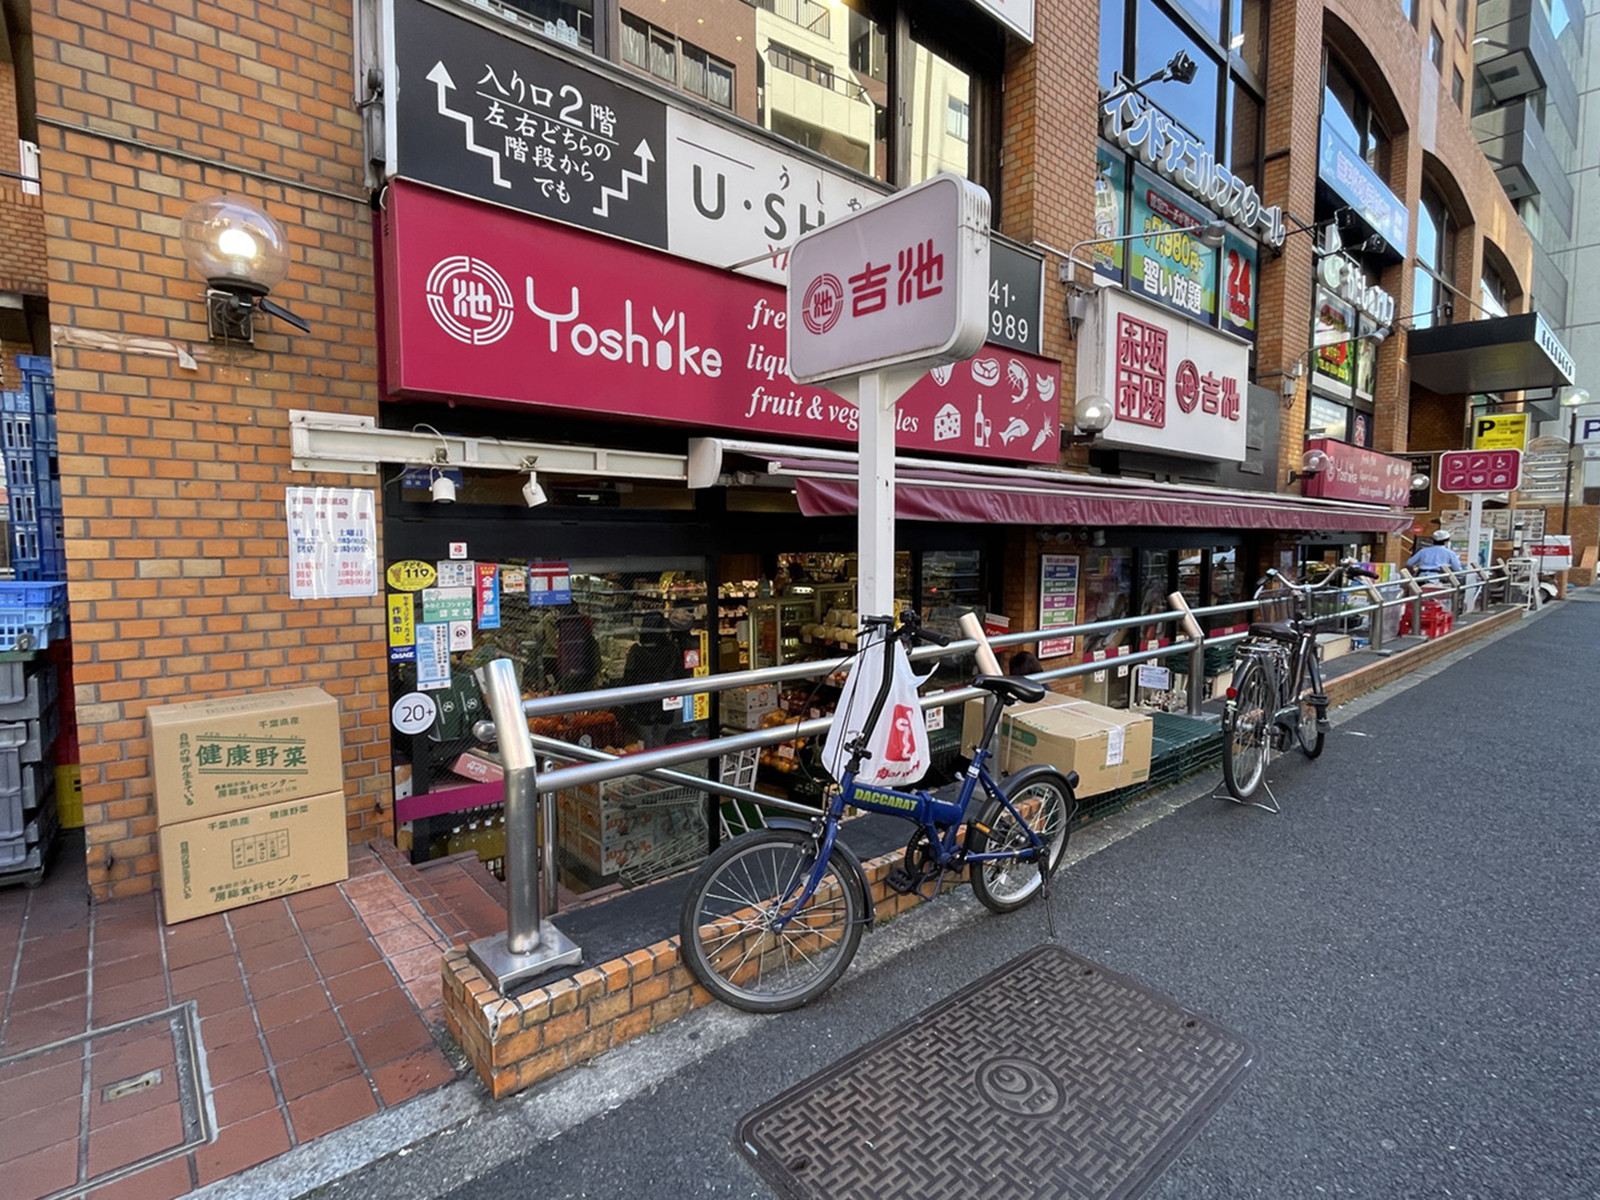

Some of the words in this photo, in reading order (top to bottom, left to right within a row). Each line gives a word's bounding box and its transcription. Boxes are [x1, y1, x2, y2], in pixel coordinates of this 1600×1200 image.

[476, 63, 617, 138] 入り口2階
[484, 103, 612, 162] 左右どちらの
[505, 136, 595, 182] 階段から
[534, 175, 571, 204] でも
[848, 238, 945, 318] 吉池
[1143, 256, 1203, 315] 習い放題
[745, 387, 803, 418] fruit
[805, 395, 824, 420] &
[828, 403, 919, 432] vegles
[1120, 373, 1165, 424] 市場
[1201, 371, 1240, 421] 吉池
[1478, 420, 1496, 437] P
[259, 716, 300, 729] 千葉県産
[402, 705, 434, 723] 20+
[196, 743, 307, 768] 健康野菜
